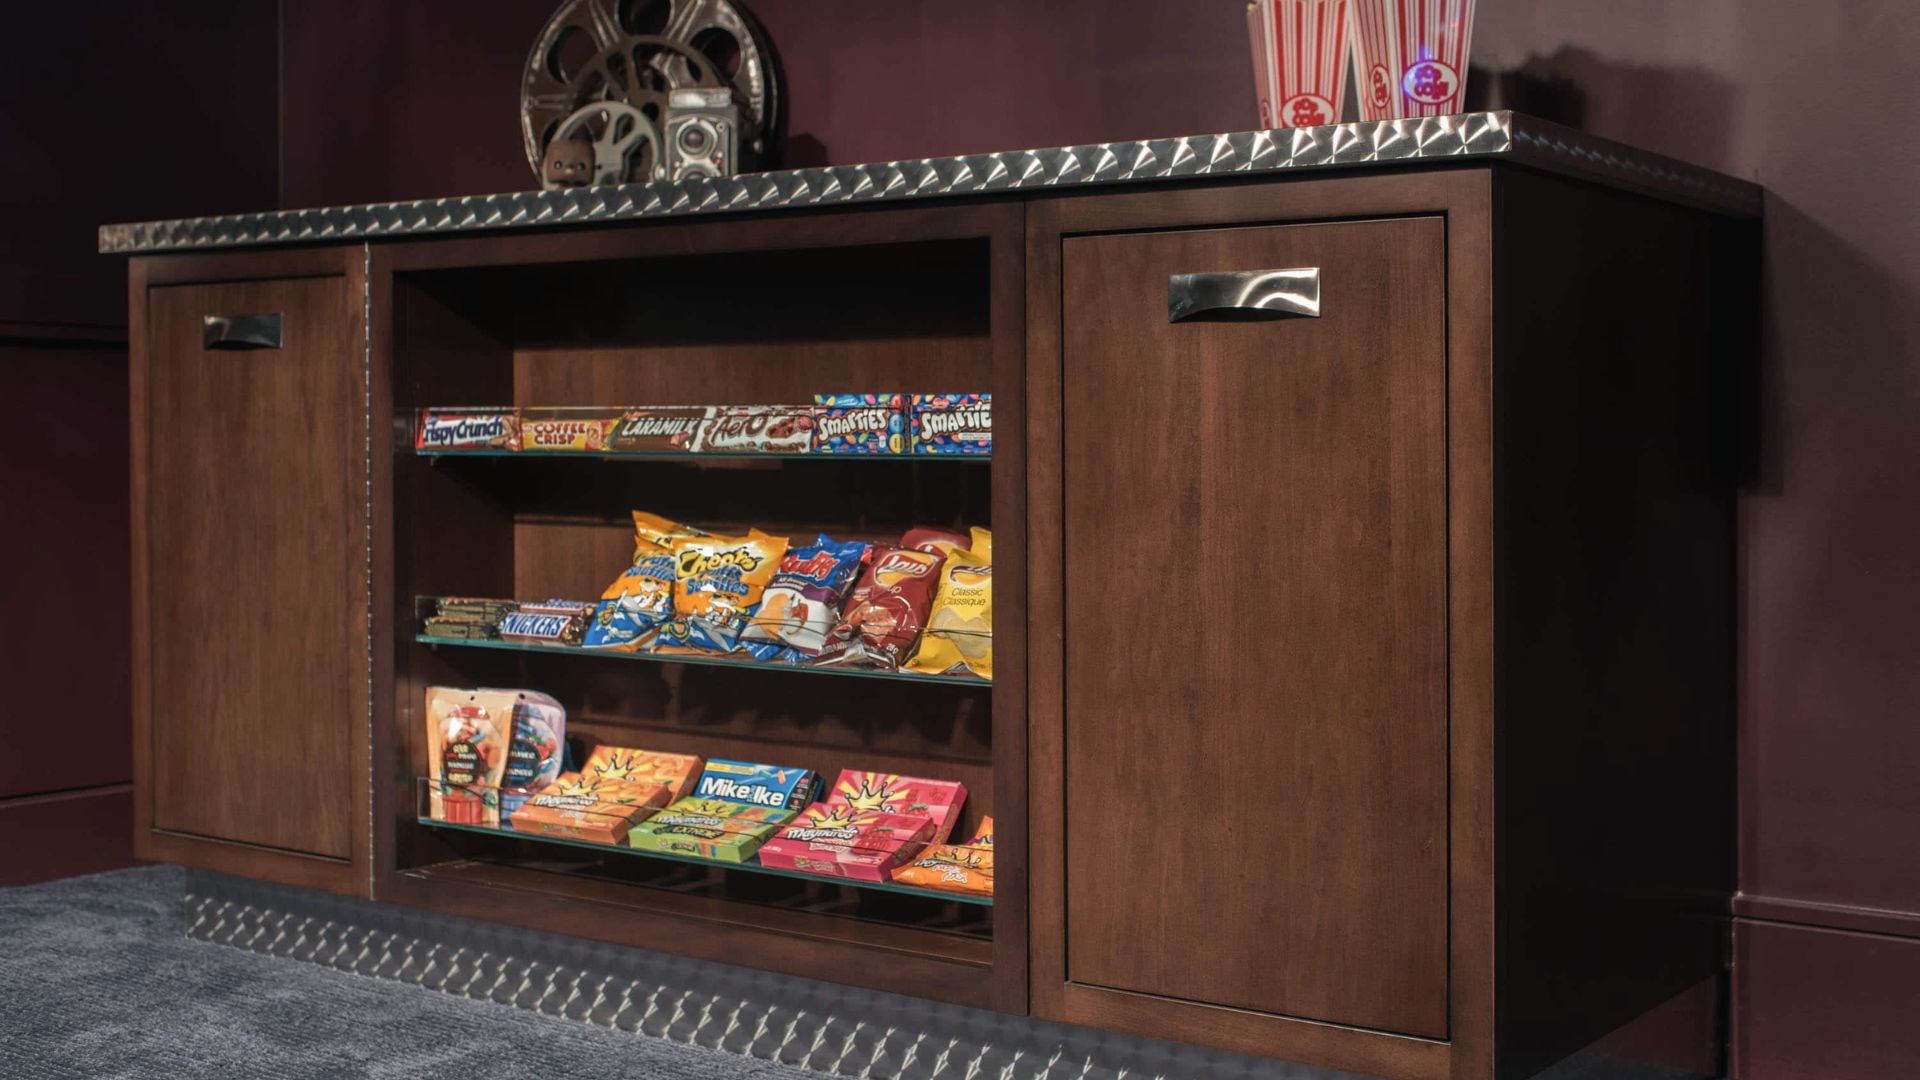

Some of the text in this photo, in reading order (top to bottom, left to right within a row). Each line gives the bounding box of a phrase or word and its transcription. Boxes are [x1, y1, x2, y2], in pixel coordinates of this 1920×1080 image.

[921, 400, 992, 440] SMARTIE
[534, 423, 586, 434] COFFEE
[534, 434, 576, 445] CRISP
[951, 588, 983, 597] Classic
[942, 598, 987, 607] Classique
[700, 776, 751, 799] Mike
[753, 785, 785, 806] Ike
